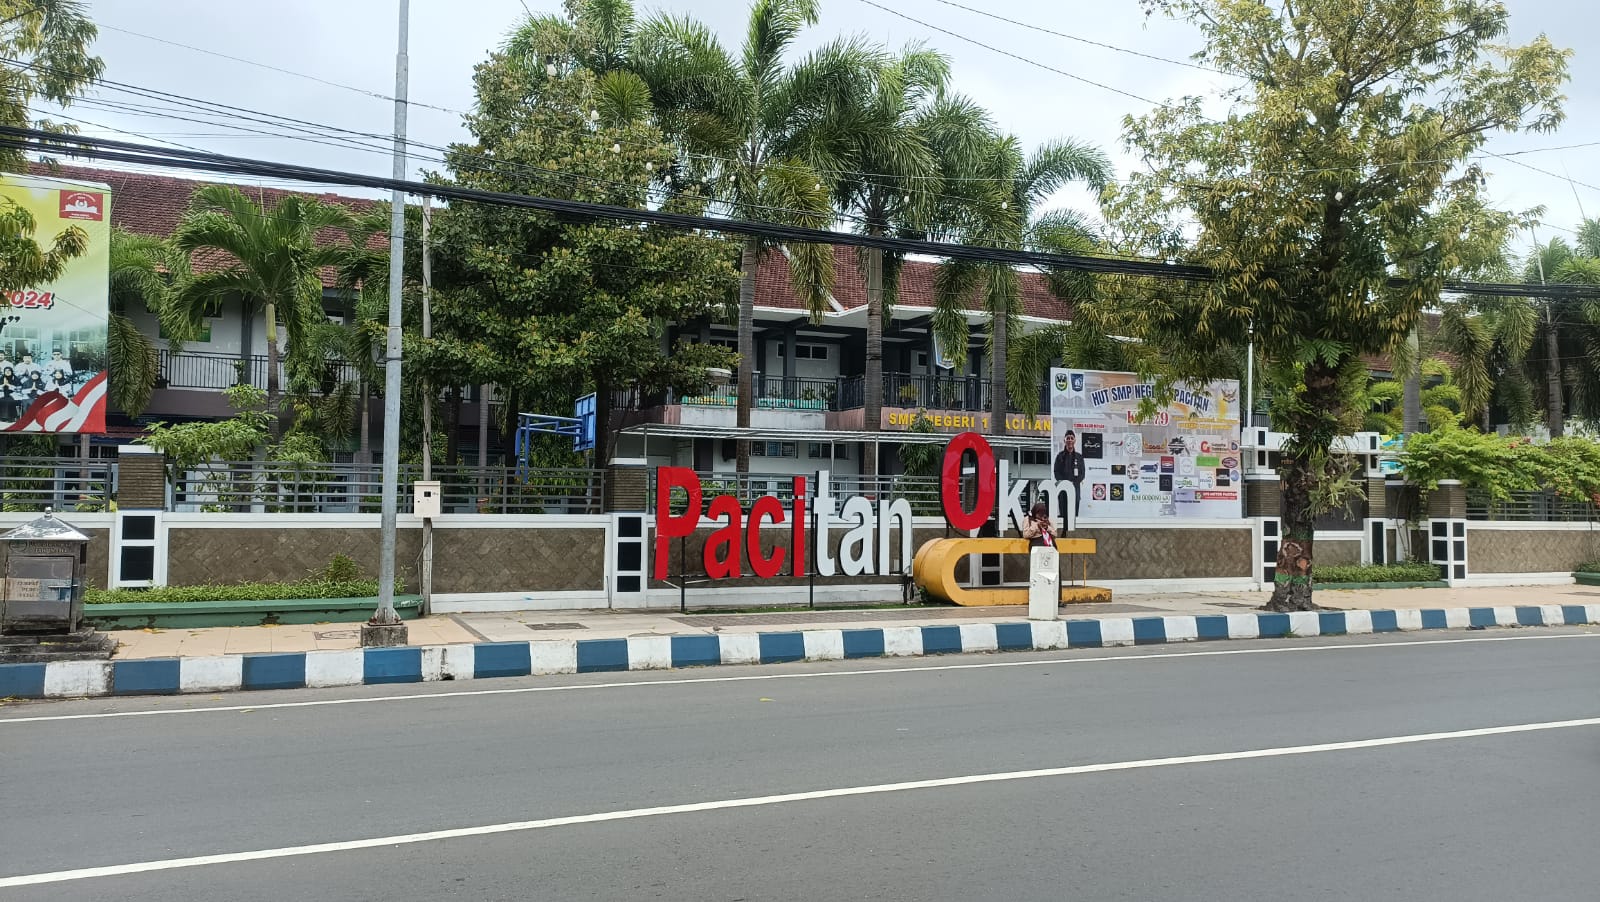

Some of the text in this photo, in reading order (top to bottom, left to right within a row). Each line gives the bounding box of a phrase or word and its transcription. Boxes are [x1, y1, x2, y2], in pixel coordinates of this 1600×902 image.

[6, 290, 53, 309] 024
[1091, 390, 1110, 406] HUT
[1111, 386, 1132, 401] SMP
[982, 417, 989, 430] 1
[654, 466, 913, 580] Pacitan
[997, 459, 1076, 531] km
